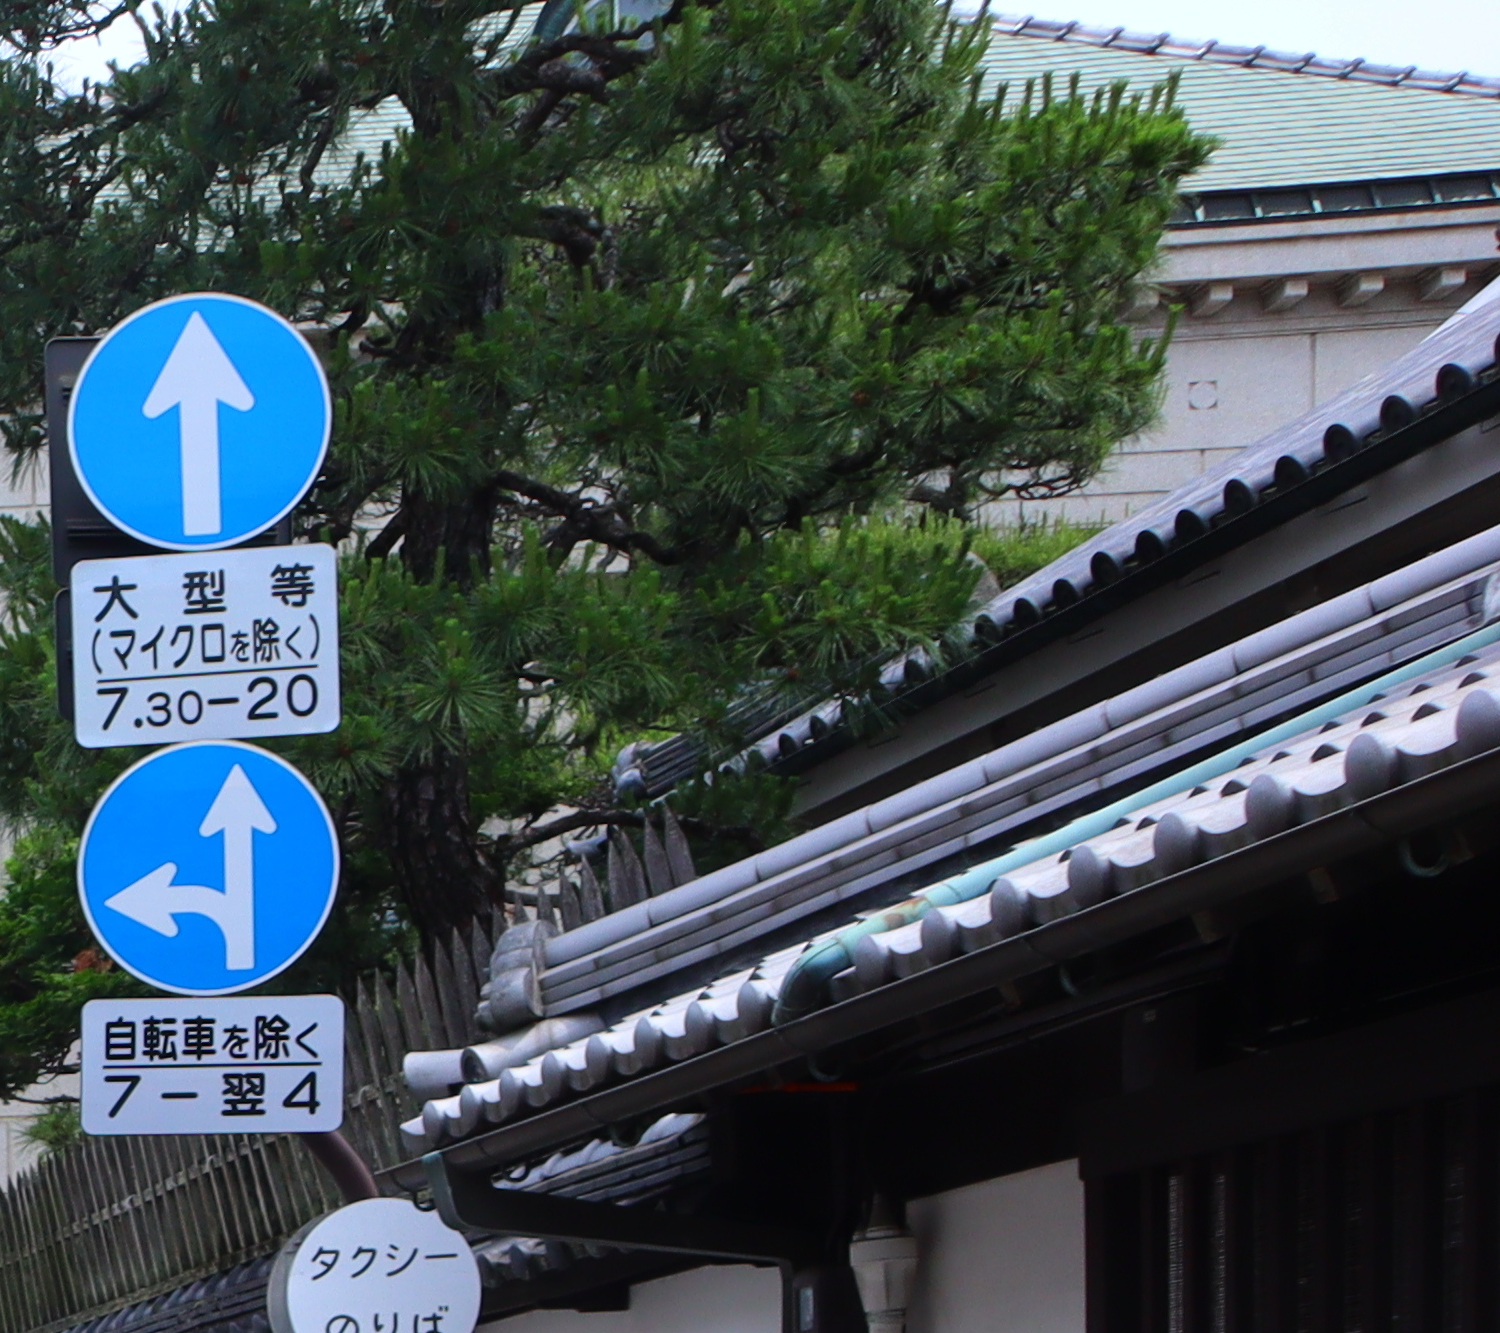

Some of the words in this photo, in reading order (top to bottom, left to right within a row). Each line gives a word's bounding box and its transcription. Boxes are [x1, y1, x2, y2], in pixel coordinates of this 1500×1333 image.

[93, 562, 315, 622] 大型等
[91, 613, 320, 674] (マイクロを除く)
[104, 1013, 319, 1062] 自転車を除く
[311, 1243, 458, 1281] タクシー
